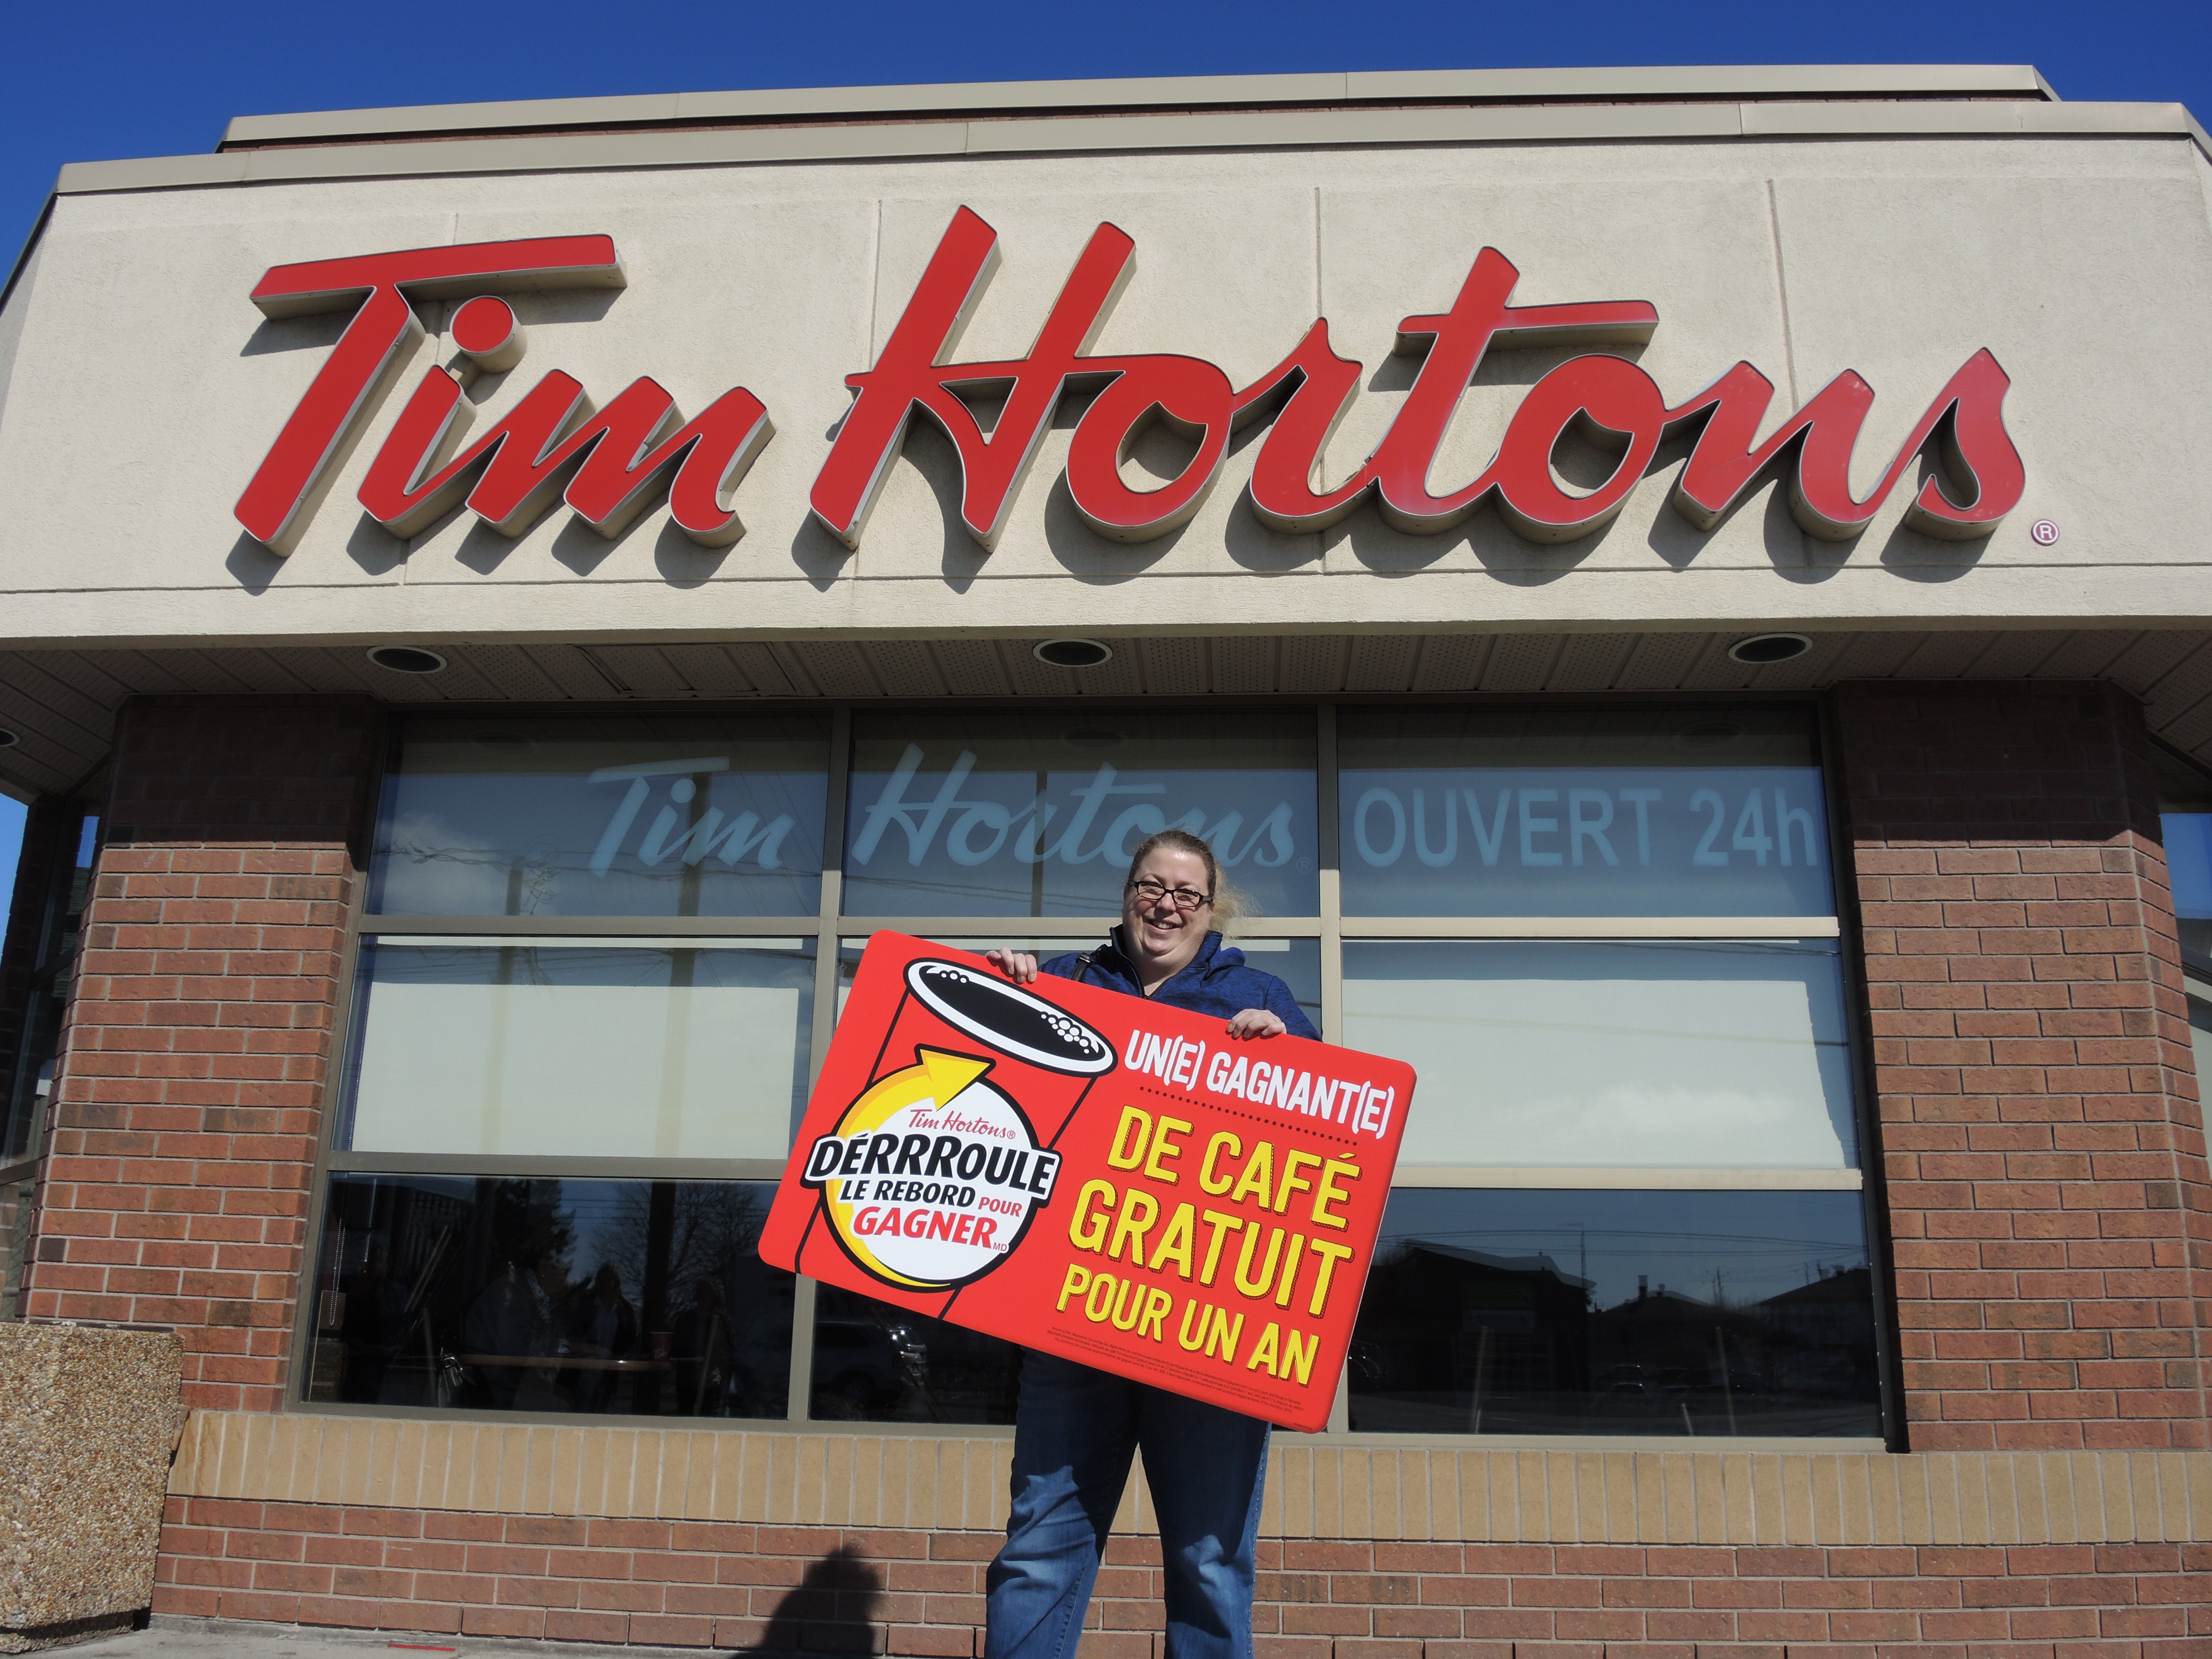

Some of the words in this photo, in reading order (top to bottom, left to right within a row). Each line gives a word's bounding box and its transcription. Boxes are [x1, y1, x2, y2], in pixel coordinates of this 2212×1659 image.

[233, 233, 775, 556] Tim
[810, 204, 2026, 552] Hortons
[588, 756, 795, 878] Tim
[1354, 787, 1662, 867] OUVERT
[1689, 788, 1817, 867] 24h
[909, 1109, 940, 1129] Tim
[1124, 1029, 1206, 1092] UN(E)
[1206, 1051, 1395, 1140] GAGNANT(E)
[810, 1133, 1056, 1196] DÉRRROULE
[840, 1180, 870, 1201] LE
[873, 1180, 976, 1208] REBORD
[978, 1197, 1022, 1218] POUR
[1108, 1105, 1194, 1185] DE
[1199, 1130, 1362, 1230] CAFÉ
[853, 1206, 998, 1249] GAGNER
[993, 1243, 1008, 1253] MD
[1070, 1178, 1355, 1319] GRATUIT
[1057, 1263, 1173, 1344] POUR
[1178, 1298, 1247, 1365] UN
[1247, 1322, 1321, 1387] AN
